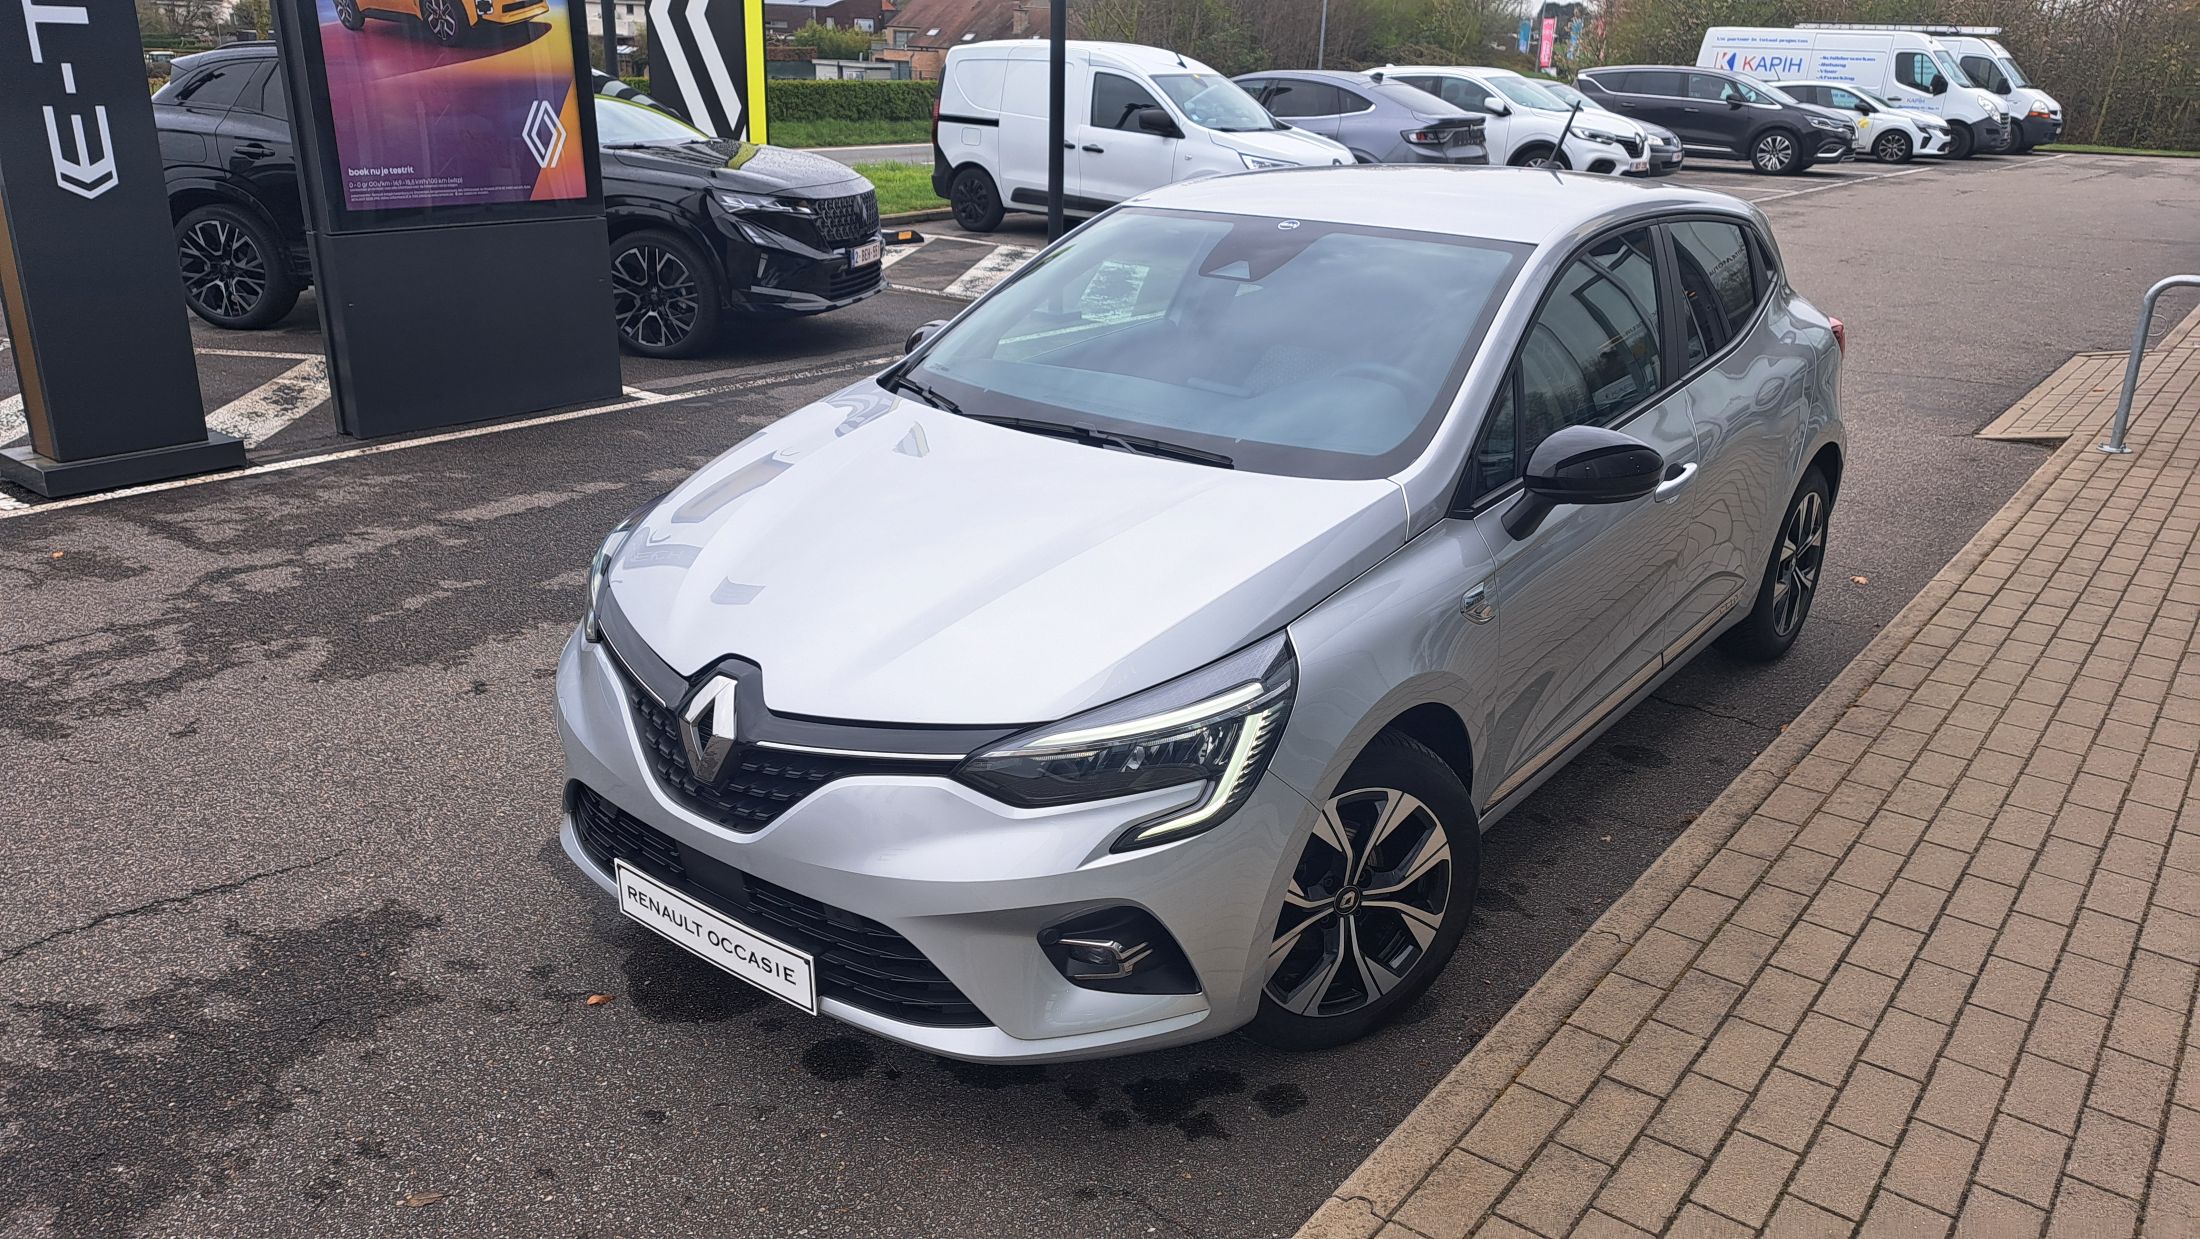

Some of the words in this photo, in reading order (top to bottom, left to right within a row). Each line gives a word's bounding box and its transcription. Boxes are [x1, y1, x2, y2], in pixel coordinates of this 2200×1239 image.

[1742, 56, 1802, 73] KAPIH
[348, 167, 369, 176] book
[381, 166, 389, 176] je
[390, 165, 415, 174] testrit
[627, 884, 703, 938] RENAULT
[707, 930, 797, 986] OCCASIE
